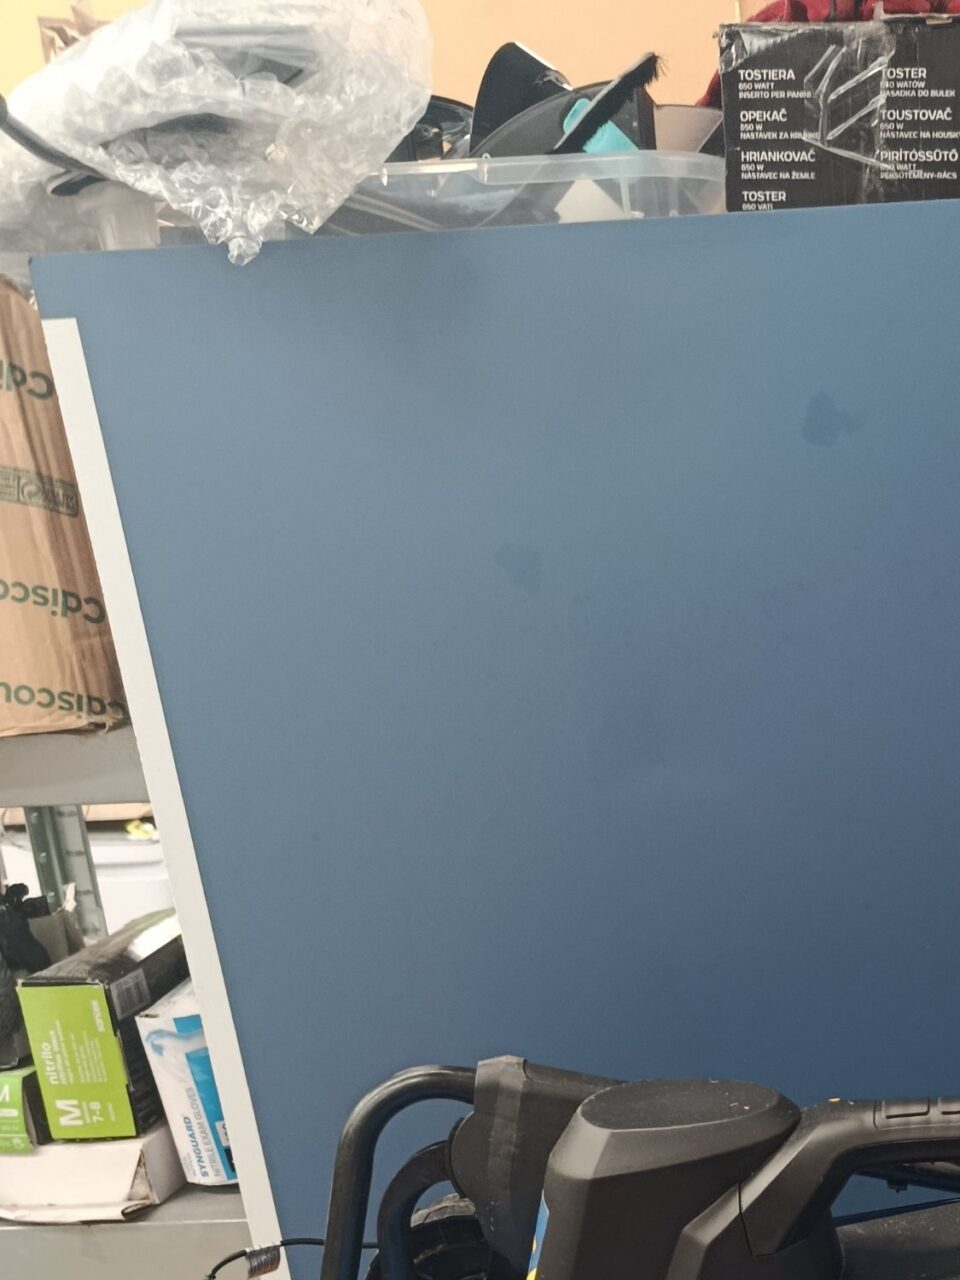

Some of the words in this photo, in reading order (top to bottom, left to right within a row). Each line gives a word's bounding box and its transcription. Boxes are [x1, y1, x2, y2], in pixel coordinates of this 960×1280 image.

[738, 69, 796, 81] TOSTIERA
[881, 67, 927, 79] TOSTER
[754, 82, 775, 90] WATT
[918, 89, 929, 97] DO
[740, 107, 788, 122] OPEKAČ
[880, 107, 953, 121] TOUSTOVAČ
[779, 131, 789, 139] ZA
[920, 131, 931, 139] NA
[741, 148, 816, 162] HRIANKOVAČ
[756, 163, 764, 171] W
[896, 163, 916, 171] WATT
[780, 171, 790, 179] NA
[742, 190, 787, 202] TOSTER
[184, 1087, 203, 1122] GLOVES
[55, 1099, 84, 1126] M
[183, 1116, 209, 1177] SYNGUARD
